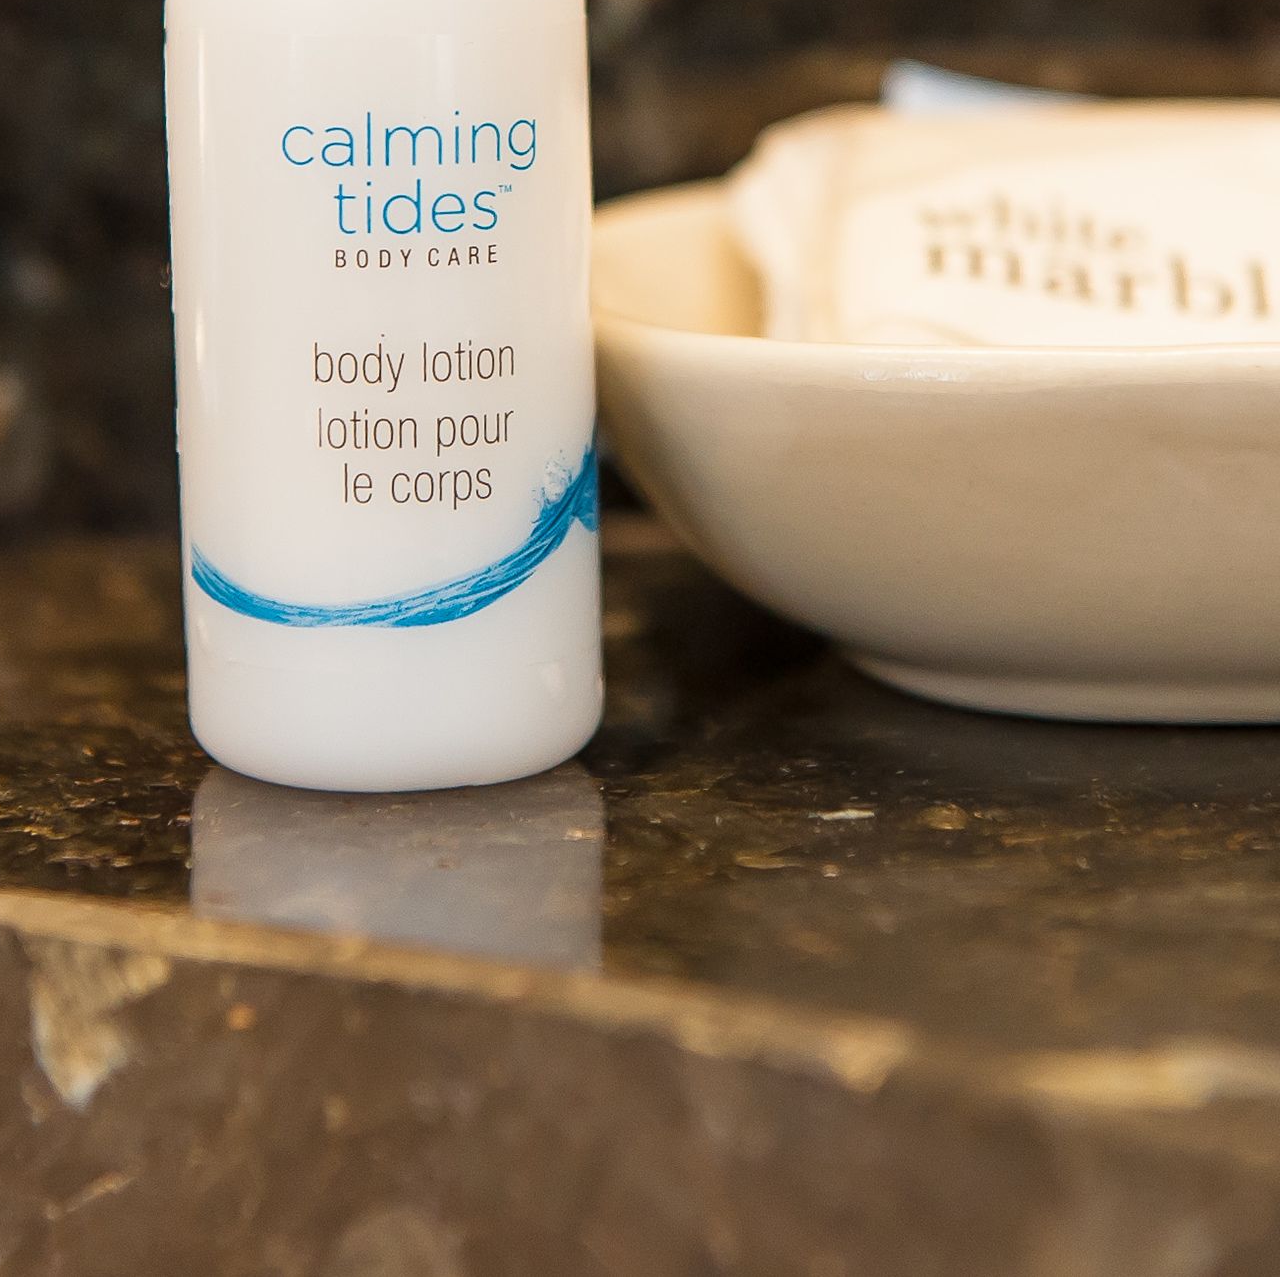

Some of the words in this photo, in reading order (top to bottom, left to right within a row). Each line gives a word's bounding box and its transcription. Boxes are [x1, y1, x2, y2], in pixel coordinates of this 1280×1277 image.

[282, 111, 537, 171] calming
[916, 188, 1144, 252] white
[334, 248, 412, 269] BODY
[427, 244, 499, 267] CARE
[313, 341, 405, 393] body
[423, 340, 516, 383] lotion
[318, 407, 418, 450] lotion
[437, 409, 515, 456] pour
[343, 463, 374, 504] le
[391, 467, 493, 510] corps
